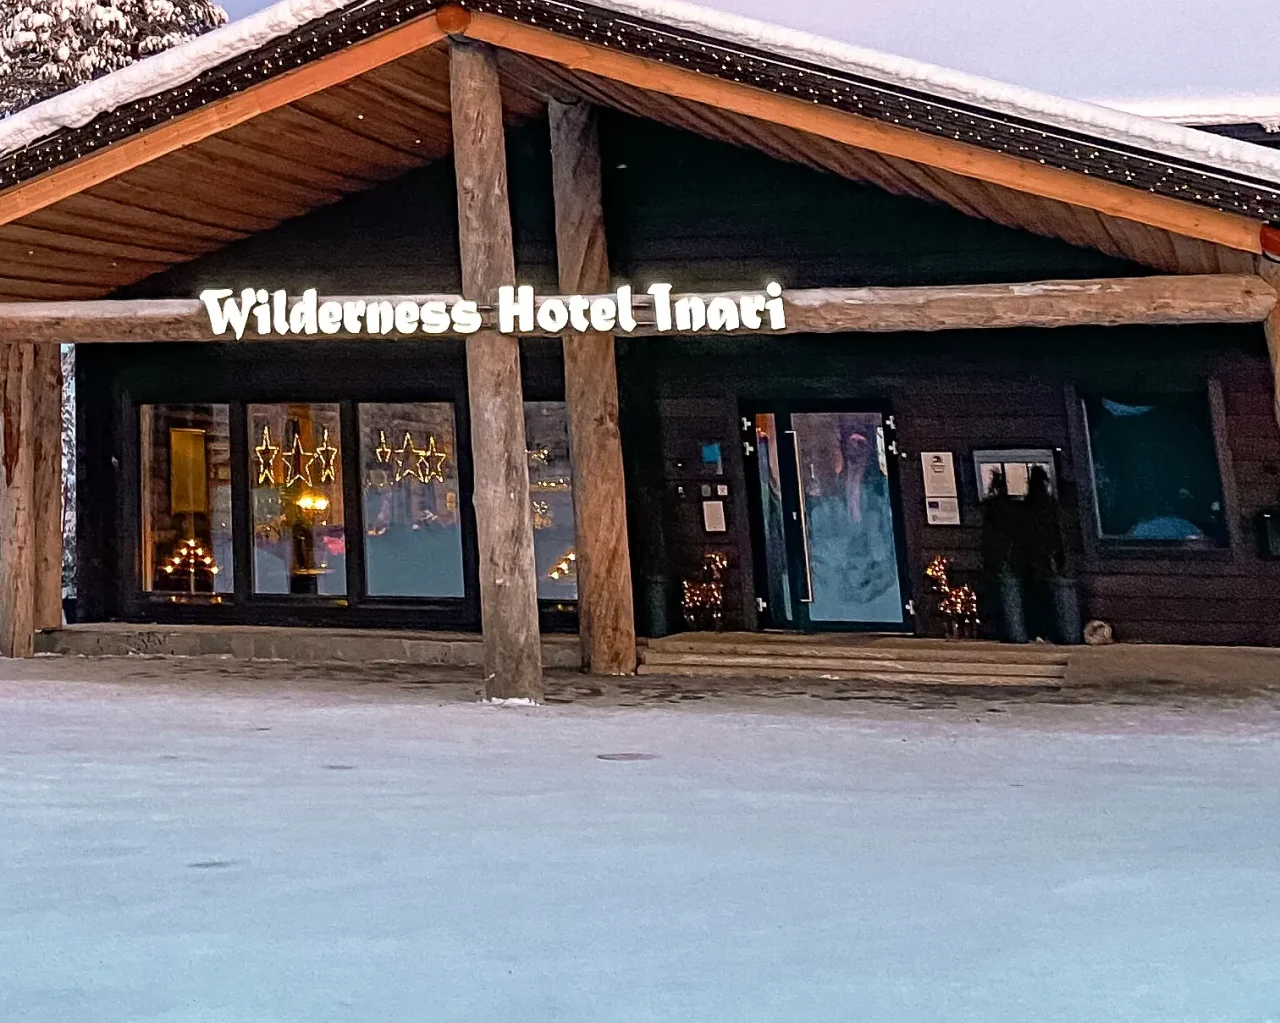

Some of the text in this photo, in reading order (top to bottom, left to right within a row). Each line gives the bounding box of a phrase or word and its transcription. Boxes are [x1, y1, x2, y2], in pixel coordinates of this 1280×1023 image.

[199, 282, 787, 340] Wilderness Hotel Inari
